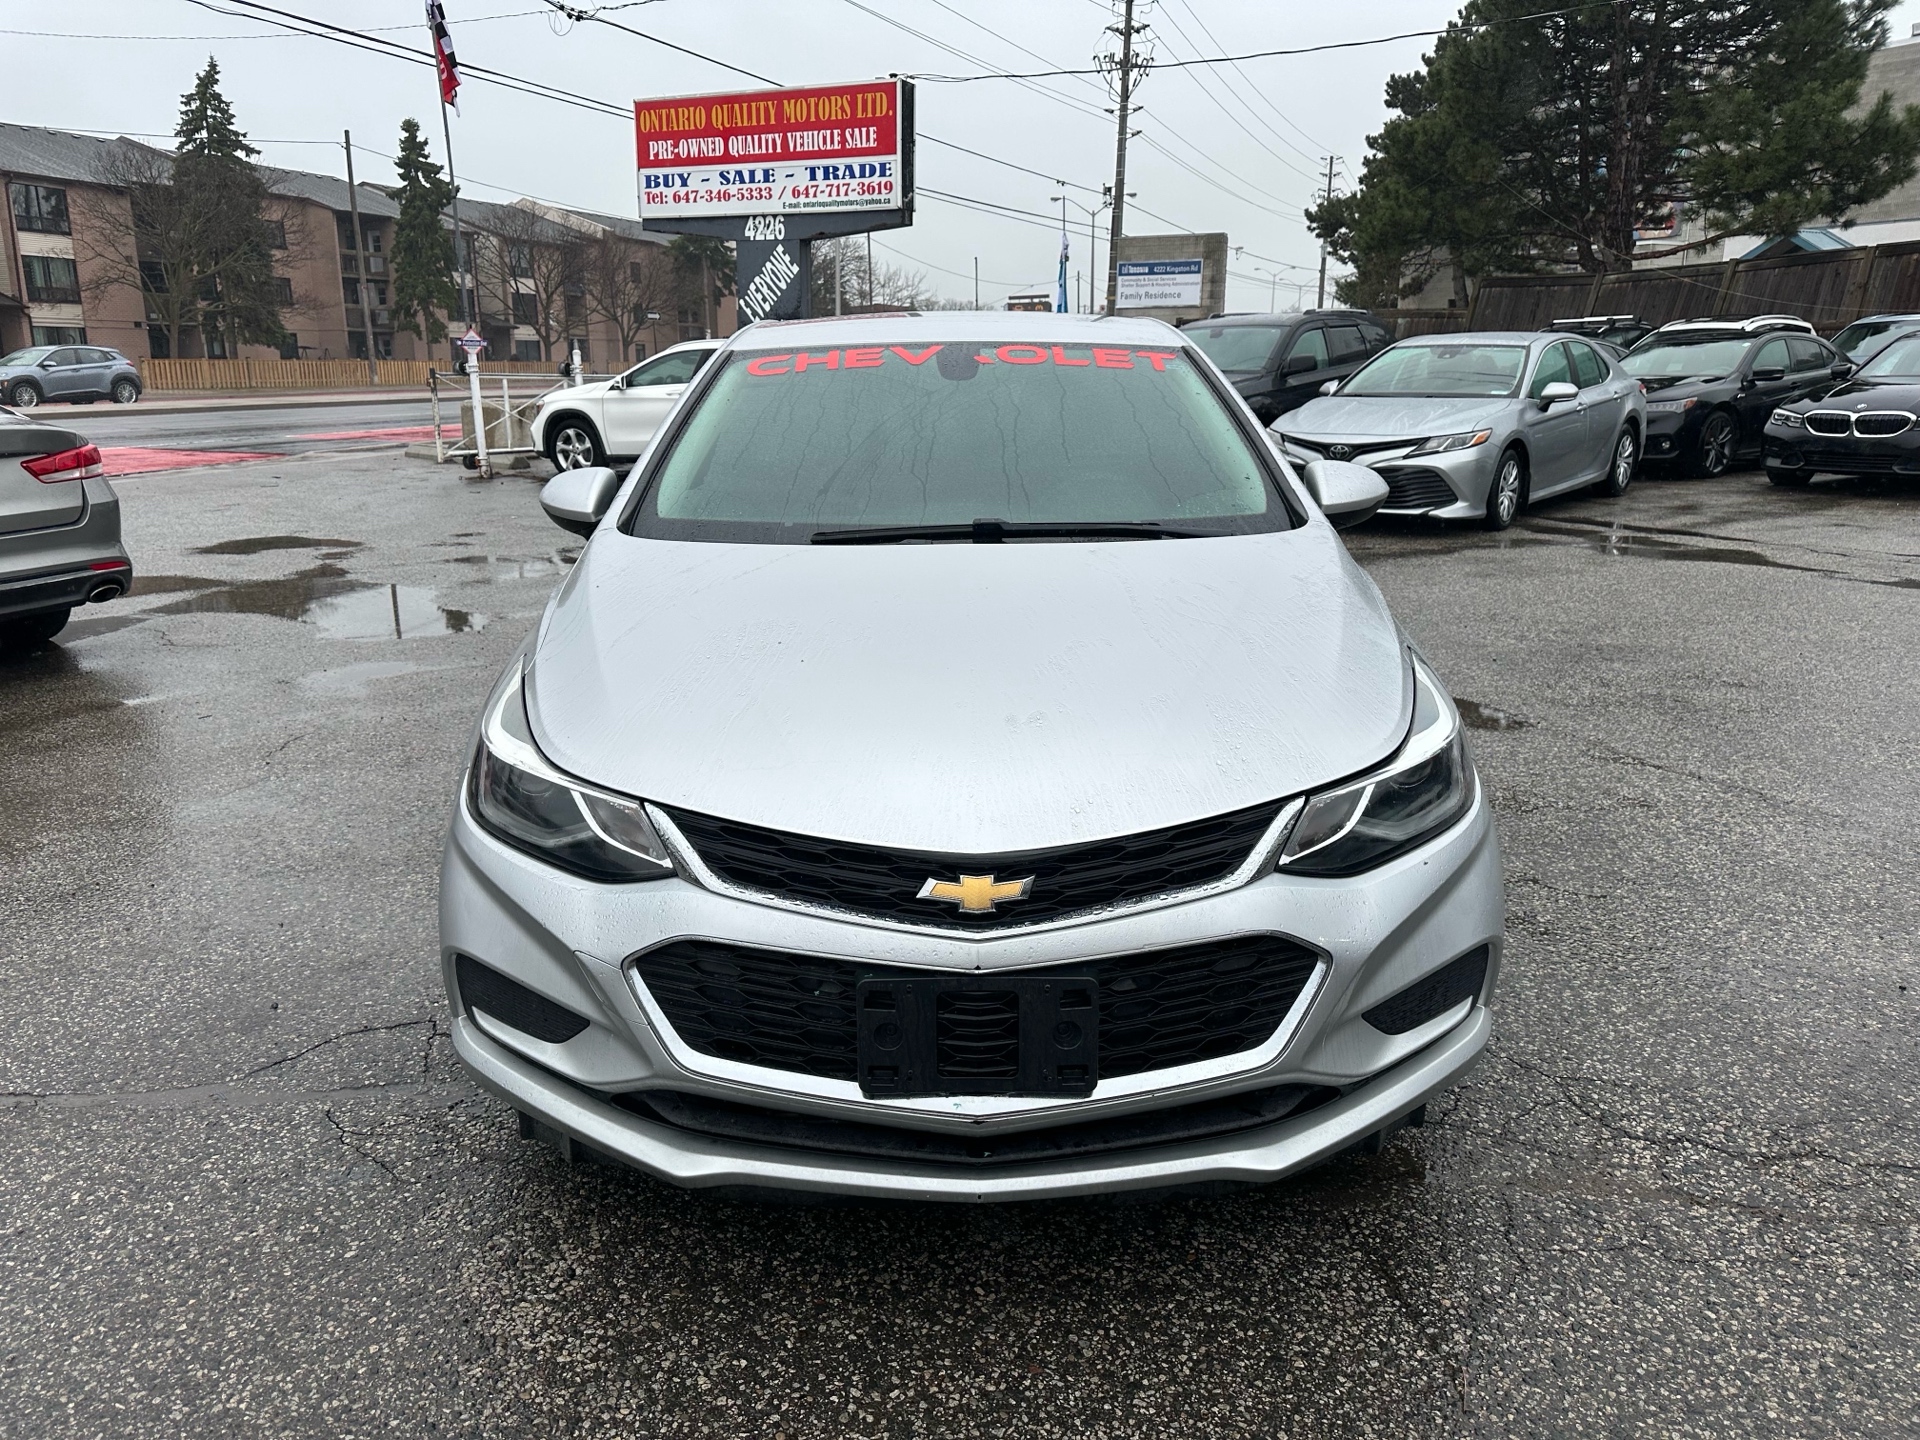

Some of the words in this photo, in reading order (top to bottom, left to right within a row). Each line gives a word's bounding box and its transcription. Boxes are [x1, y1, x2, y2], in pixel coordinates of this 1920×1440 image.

[640, 105, 706, 133] ONTARIO
[711, 100, 777, 131] QUALITY
[783, 94, 851, 124] MOTORS
[856, 91, 893, 119] LTD.
[648, 136, 724, 160] PRE-OWNED
[728, 132, 783, 158] QUALITY
[787, 129, 841, 152] VEHICLE
[845, 126, 877, 149] SALE
[644, 172, 692, 189] BUY
[719, 168, 776, 186] SALE
[805, 162, 893, 182] TRADE
[644, 191, 668, 204] Tel:
[672, 186, 773, 204] 647-346-5333
[778, 185, 787, 200] /
[791, 180, 894, 199] 647-717-3619
[782, 201, 801, 209] E-mail:
[802, 197, 891, 209] ontarioqualitymotors@yahoo.ca
[744, 215, 785, 241] 4226
[1153, 265, 1166, 273] 4222
[1166, 265, 1190, 273] Kingston
[1190, 264, 1198, 272] Rd
[739, 243, 800, 322] EVERYONE
[1120, 291, 1143, 301] Family
[1144, 291, 1182, 300] Residence
[747, 344, 1177, 376] CHEVOLET
